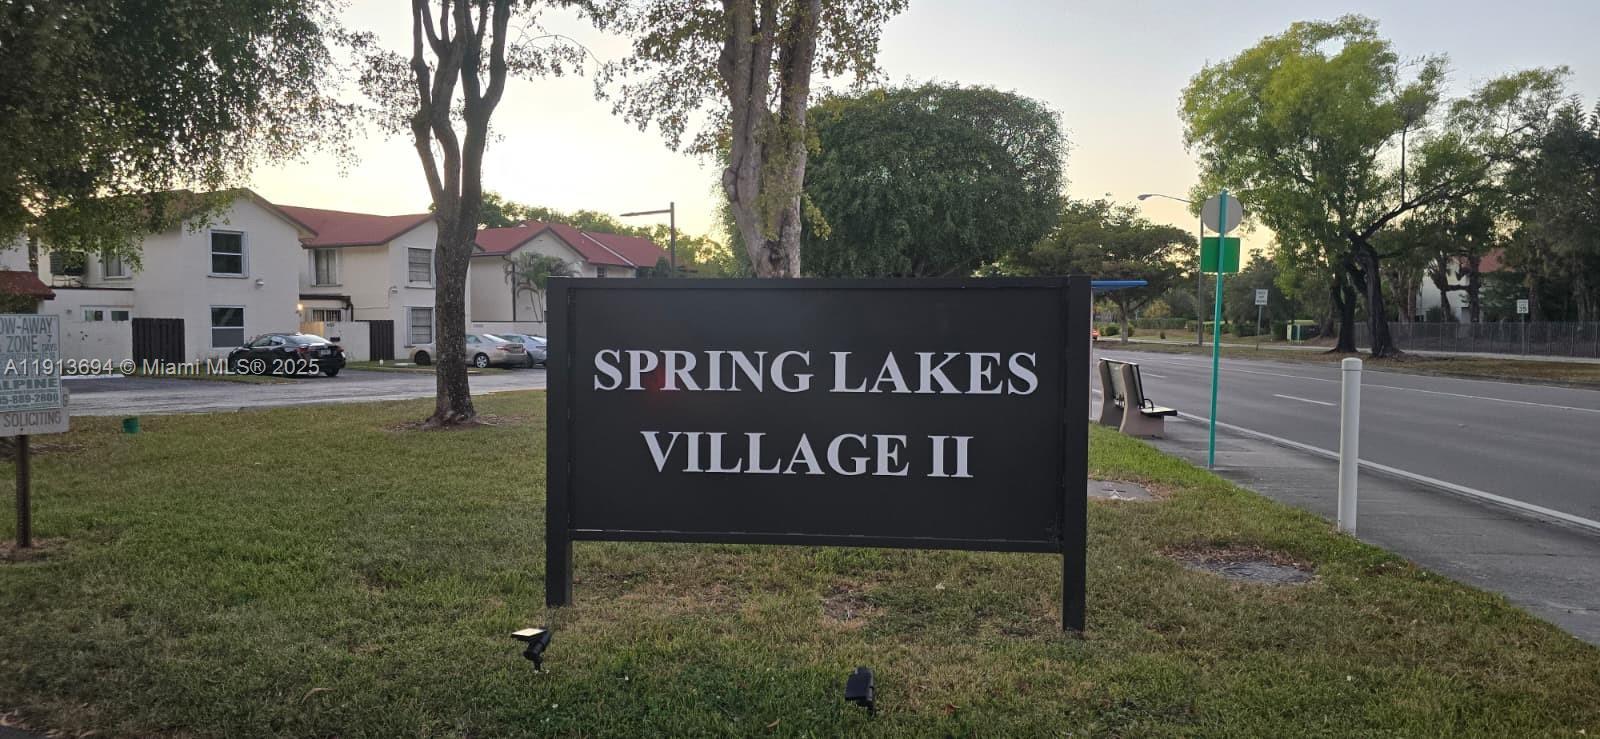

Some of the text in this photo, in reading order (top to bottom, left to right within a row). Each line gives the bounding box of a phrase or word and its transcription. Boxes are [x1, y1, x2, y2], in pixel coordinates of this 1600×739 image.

[6, 335, 39, 352] ZONE
[594, 349, 1039, 395] SPRING LAKES
[0, 378, 58, 390] LPINE
[3, 411, 62, 428] SOLICITING
[640, 430, 974, 478] VILLAGE II
